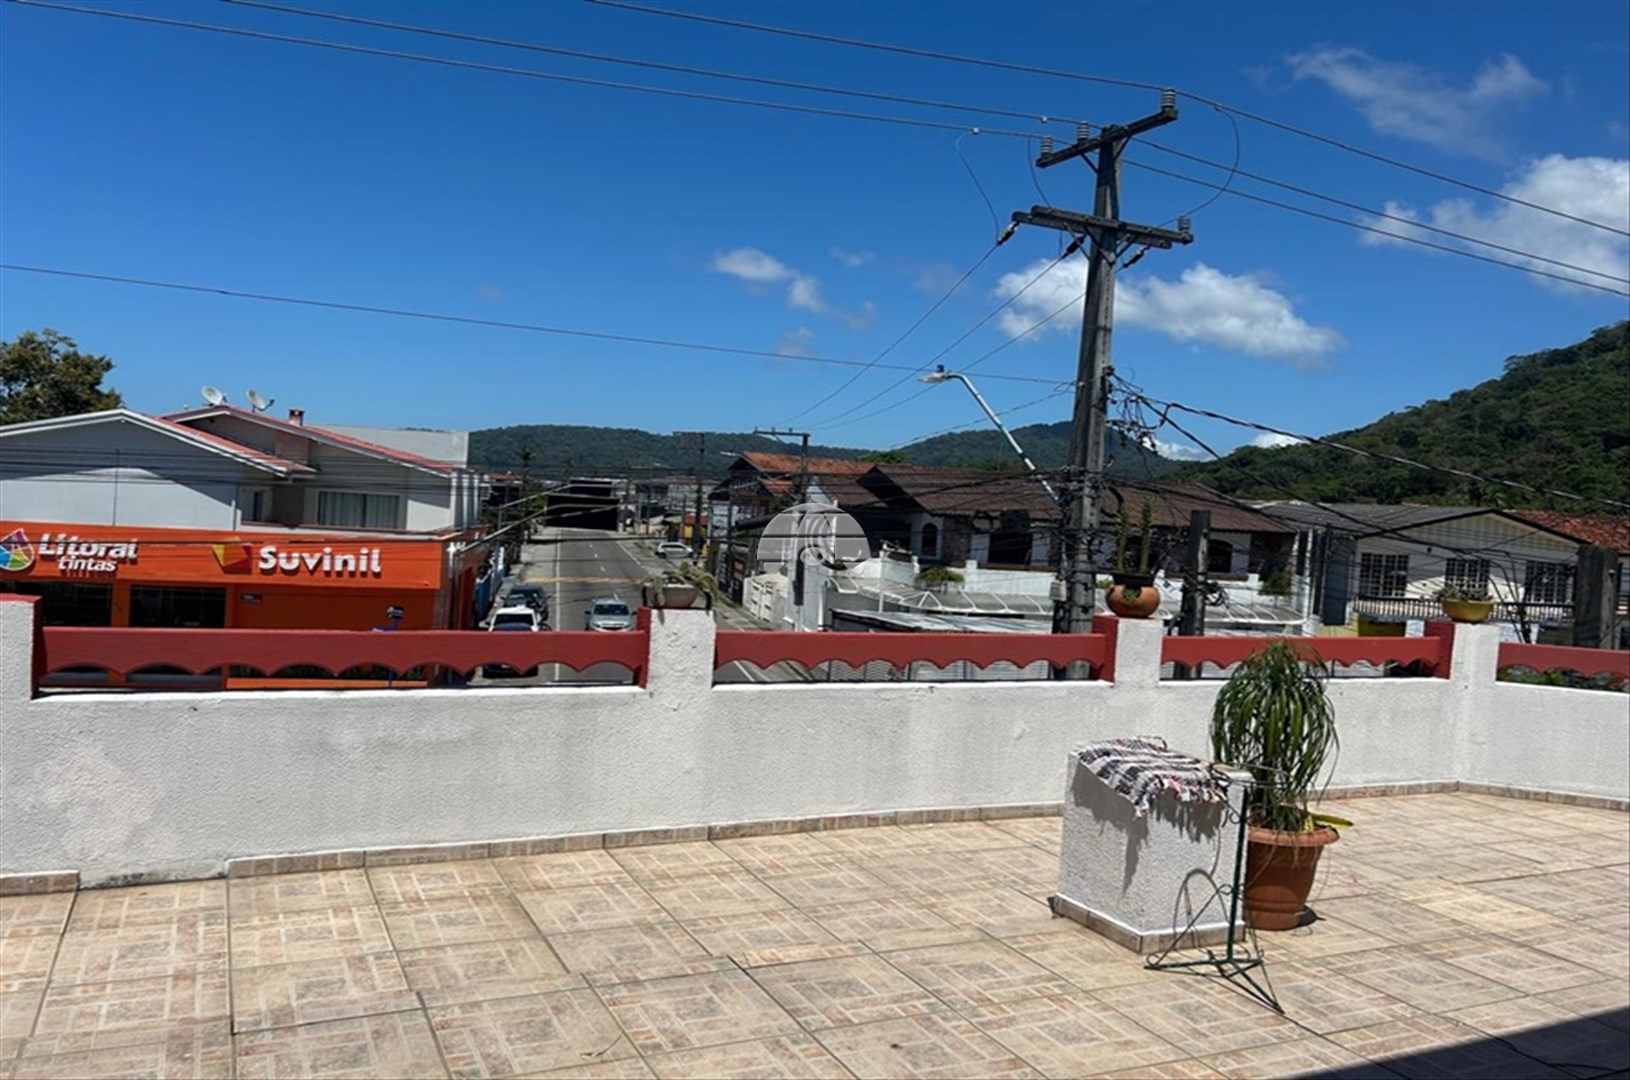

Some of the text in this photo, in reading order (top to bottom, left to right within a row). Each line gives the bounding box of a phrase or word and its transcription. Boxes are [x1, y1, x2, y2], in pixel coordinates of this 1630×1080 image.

[38, 533, 139, 559] Litoral
[258, 545, 382, 573] Suvinil
[58, 555, 117, 572] tintas
